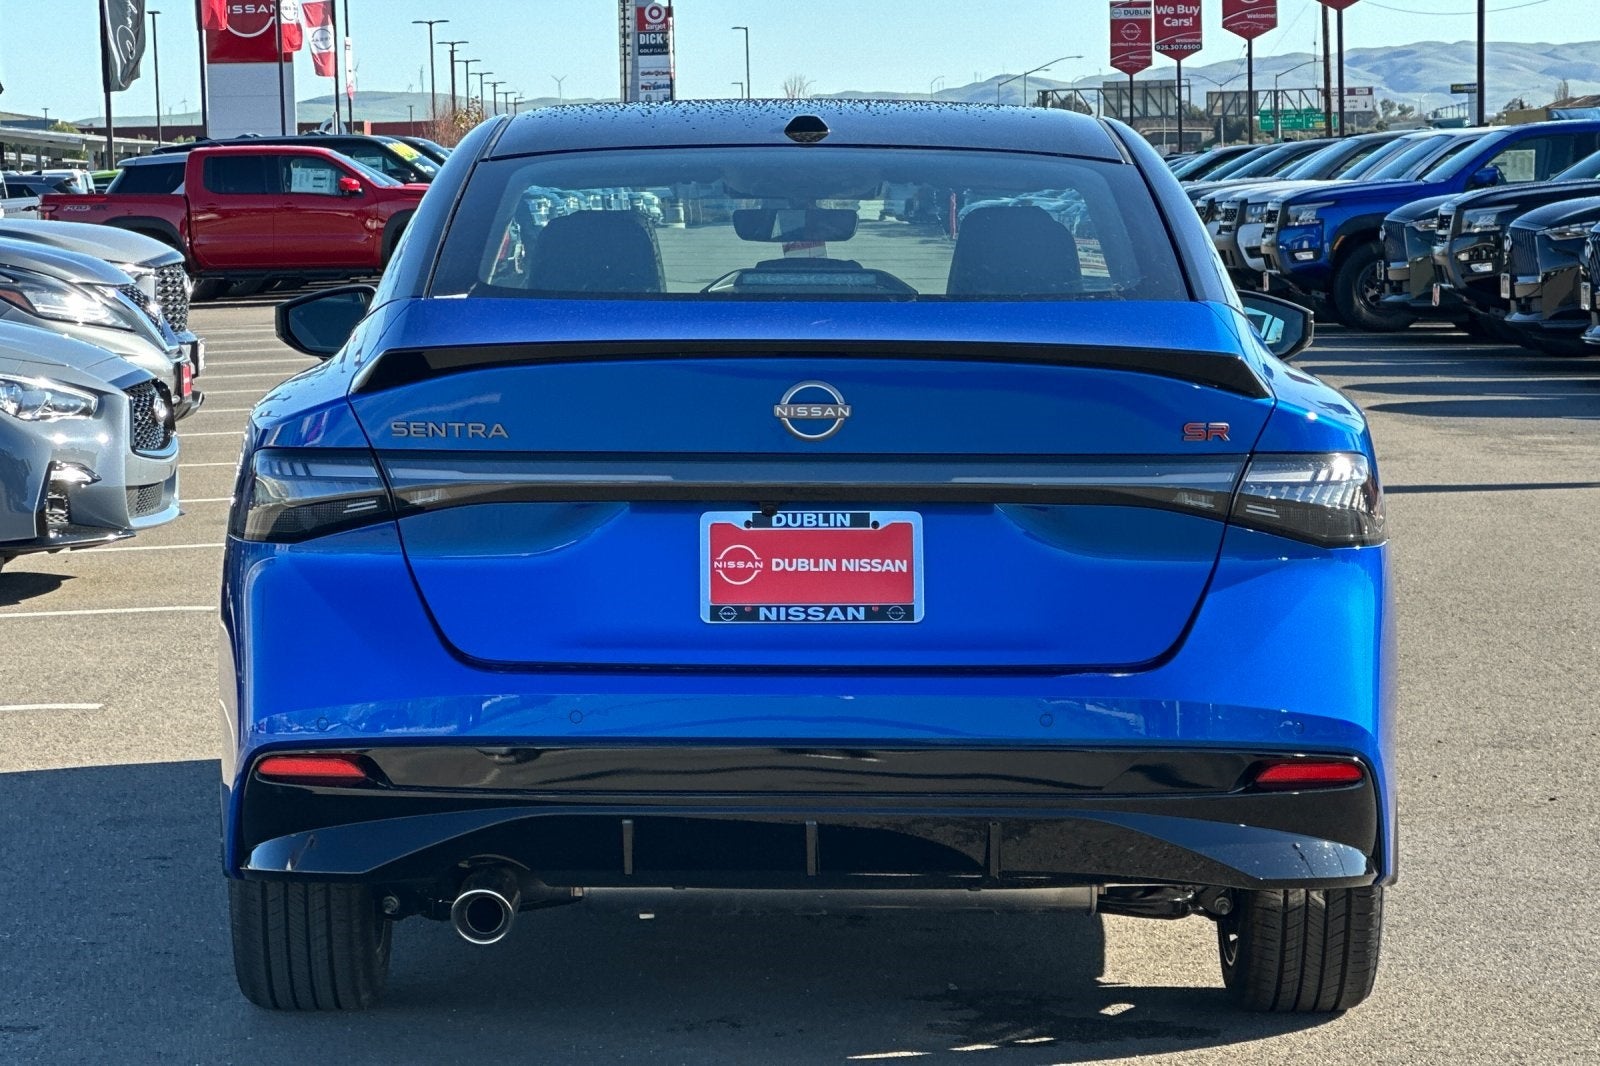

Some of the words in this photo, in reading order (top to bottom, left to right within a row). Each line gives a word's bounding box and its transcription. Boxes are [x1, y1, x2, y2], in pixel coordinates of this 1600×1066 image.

[1156, 5, 1174, 14] We
[1177, 5, 1200, 16] Buy
[1163, 17, 1193, 27] Cars!
[776, 406, 850, 417] NISSAN
[391, 421, 509, 439] SENTRA
[1183, 422, 1230, 441] SR
[771, 512, 851, 528] DUBLIN
[714, 560, 764, 569] NISSAN
[771, 558, 837, 572] DUBLIN
[841, 559, 908, 573] NISSAN
[759, 606, 866, 621] NISSAN
